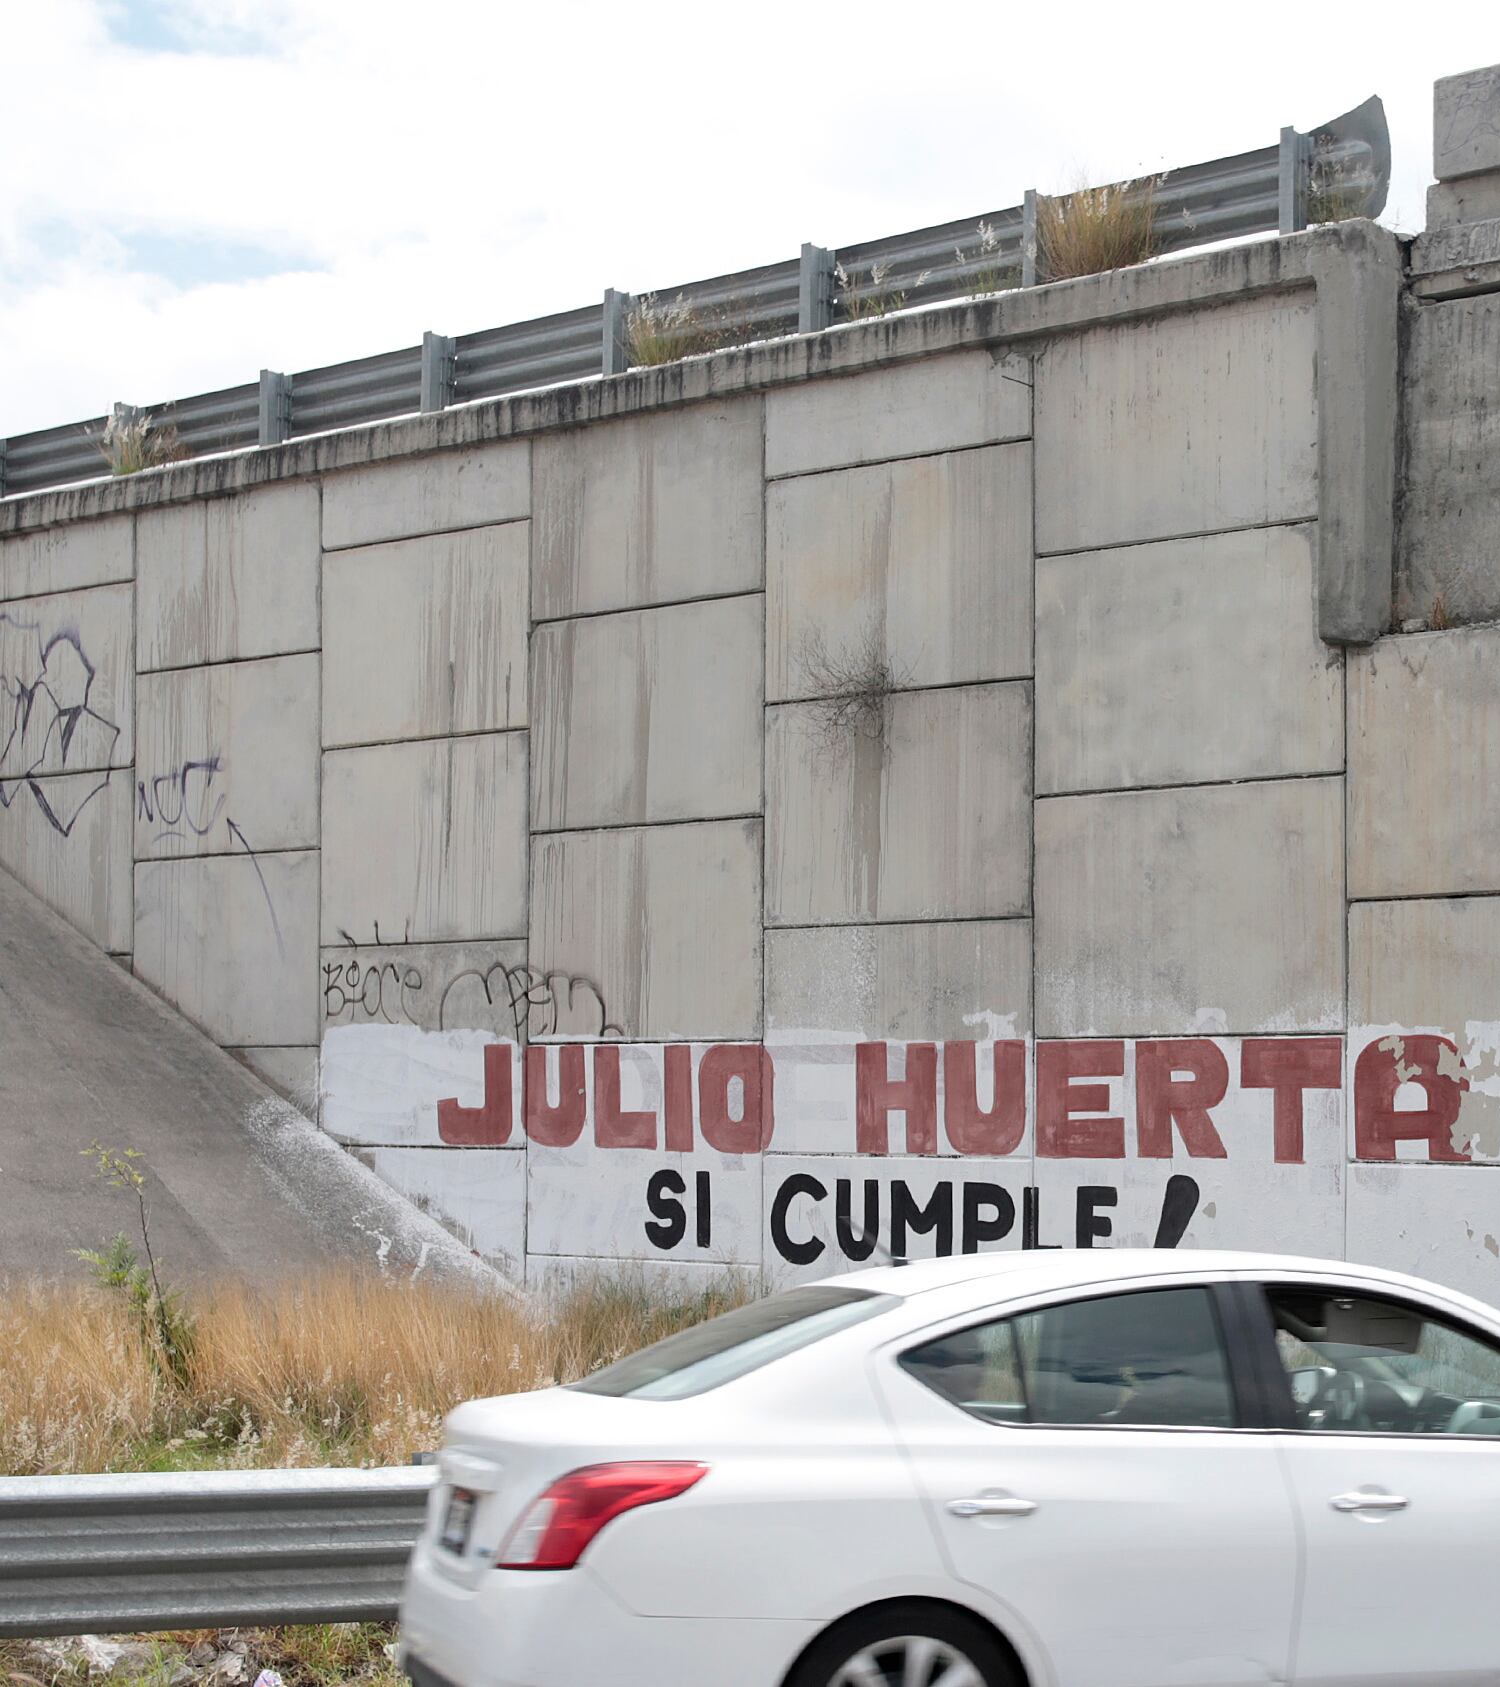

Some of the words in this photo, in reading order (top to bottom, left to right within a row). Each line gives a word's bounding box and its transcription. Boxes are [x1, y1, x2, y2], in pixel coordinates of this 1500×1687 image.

[437, 1043, 775, 1154] JULIO
[855, 1034, 1472, 1164] HUERTA
[645, 1169, 711, 1250] SI
